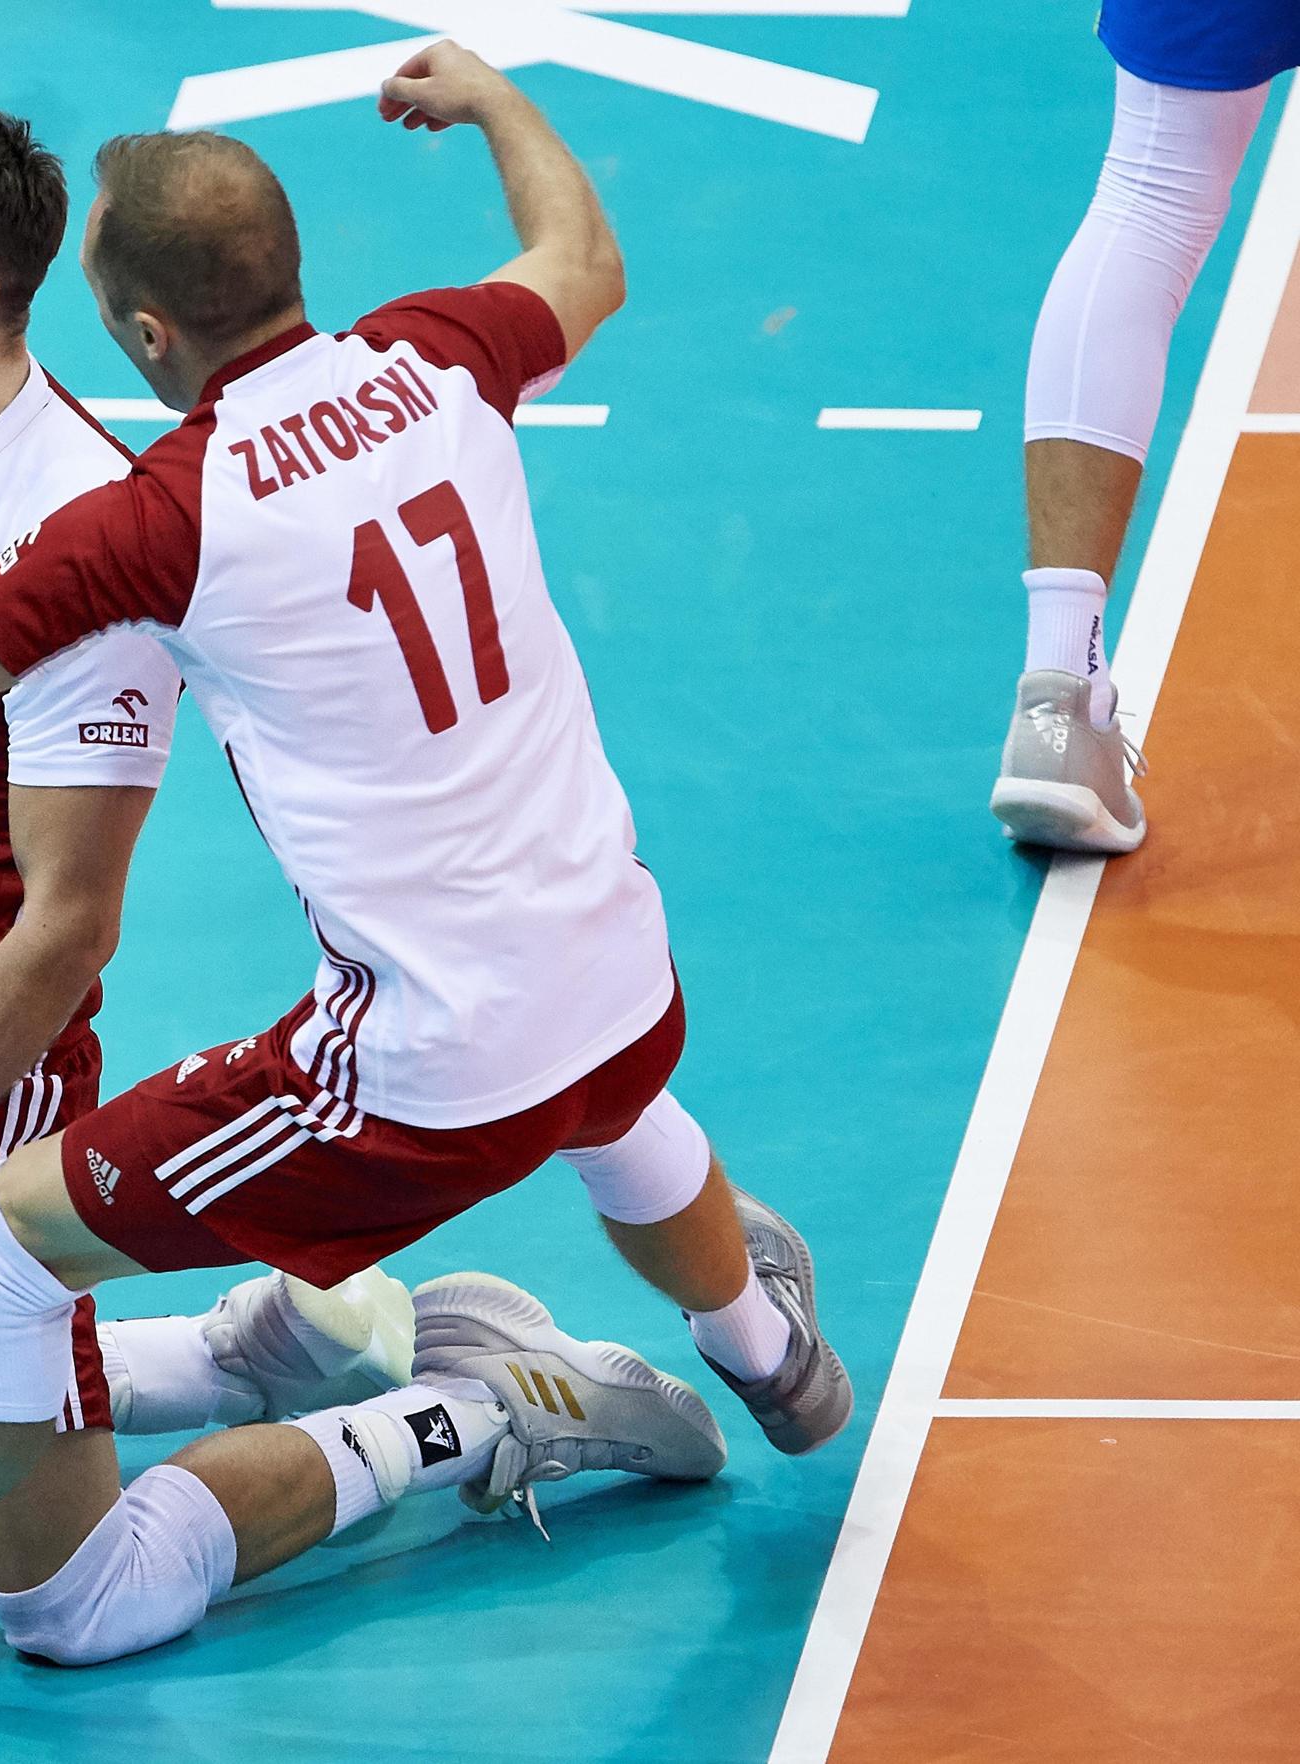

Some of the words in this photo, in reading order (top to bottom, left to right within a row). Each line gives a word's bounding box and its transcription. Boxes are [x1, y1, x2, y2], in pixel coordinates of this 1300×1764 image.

[228, 357, 438, 501] ZATORSKI
[346, 479, 511, 735] 17
[83, 724, 145, 744] ORLEN
[86, 1147, 115, 1205] adidas
